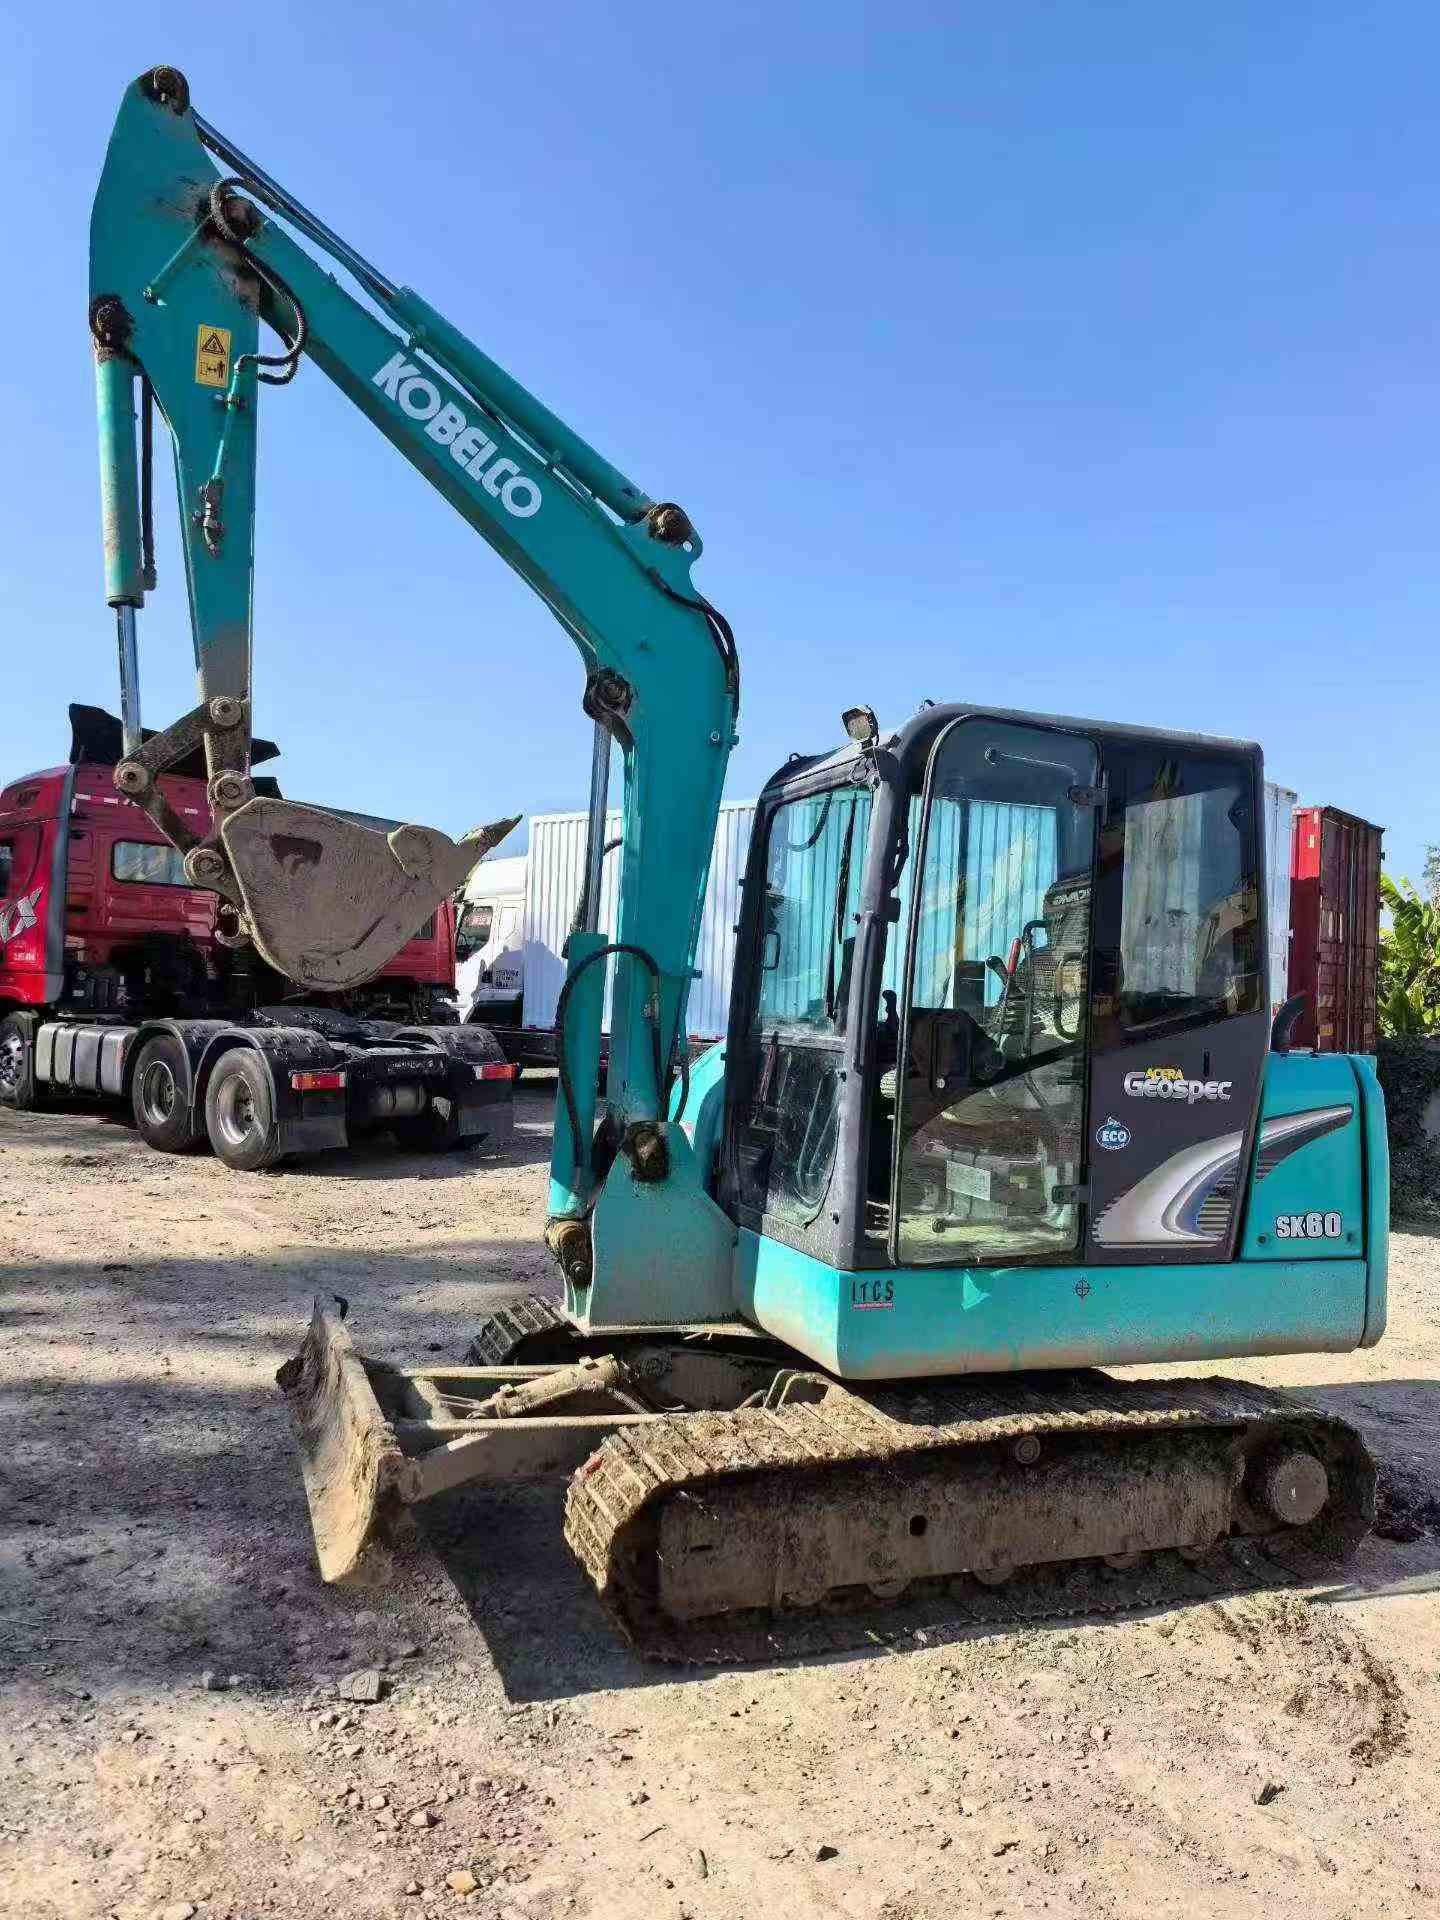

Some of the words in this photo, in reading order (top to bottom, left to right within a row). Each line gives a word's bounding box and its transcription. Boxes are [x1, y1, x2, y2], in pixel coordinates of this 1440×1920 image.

[372, 351, 542, 518] KOBELCO
[1102, 1130, 1127, 1142] ECO
[1276, 1212, 1342, 1238] SK60
